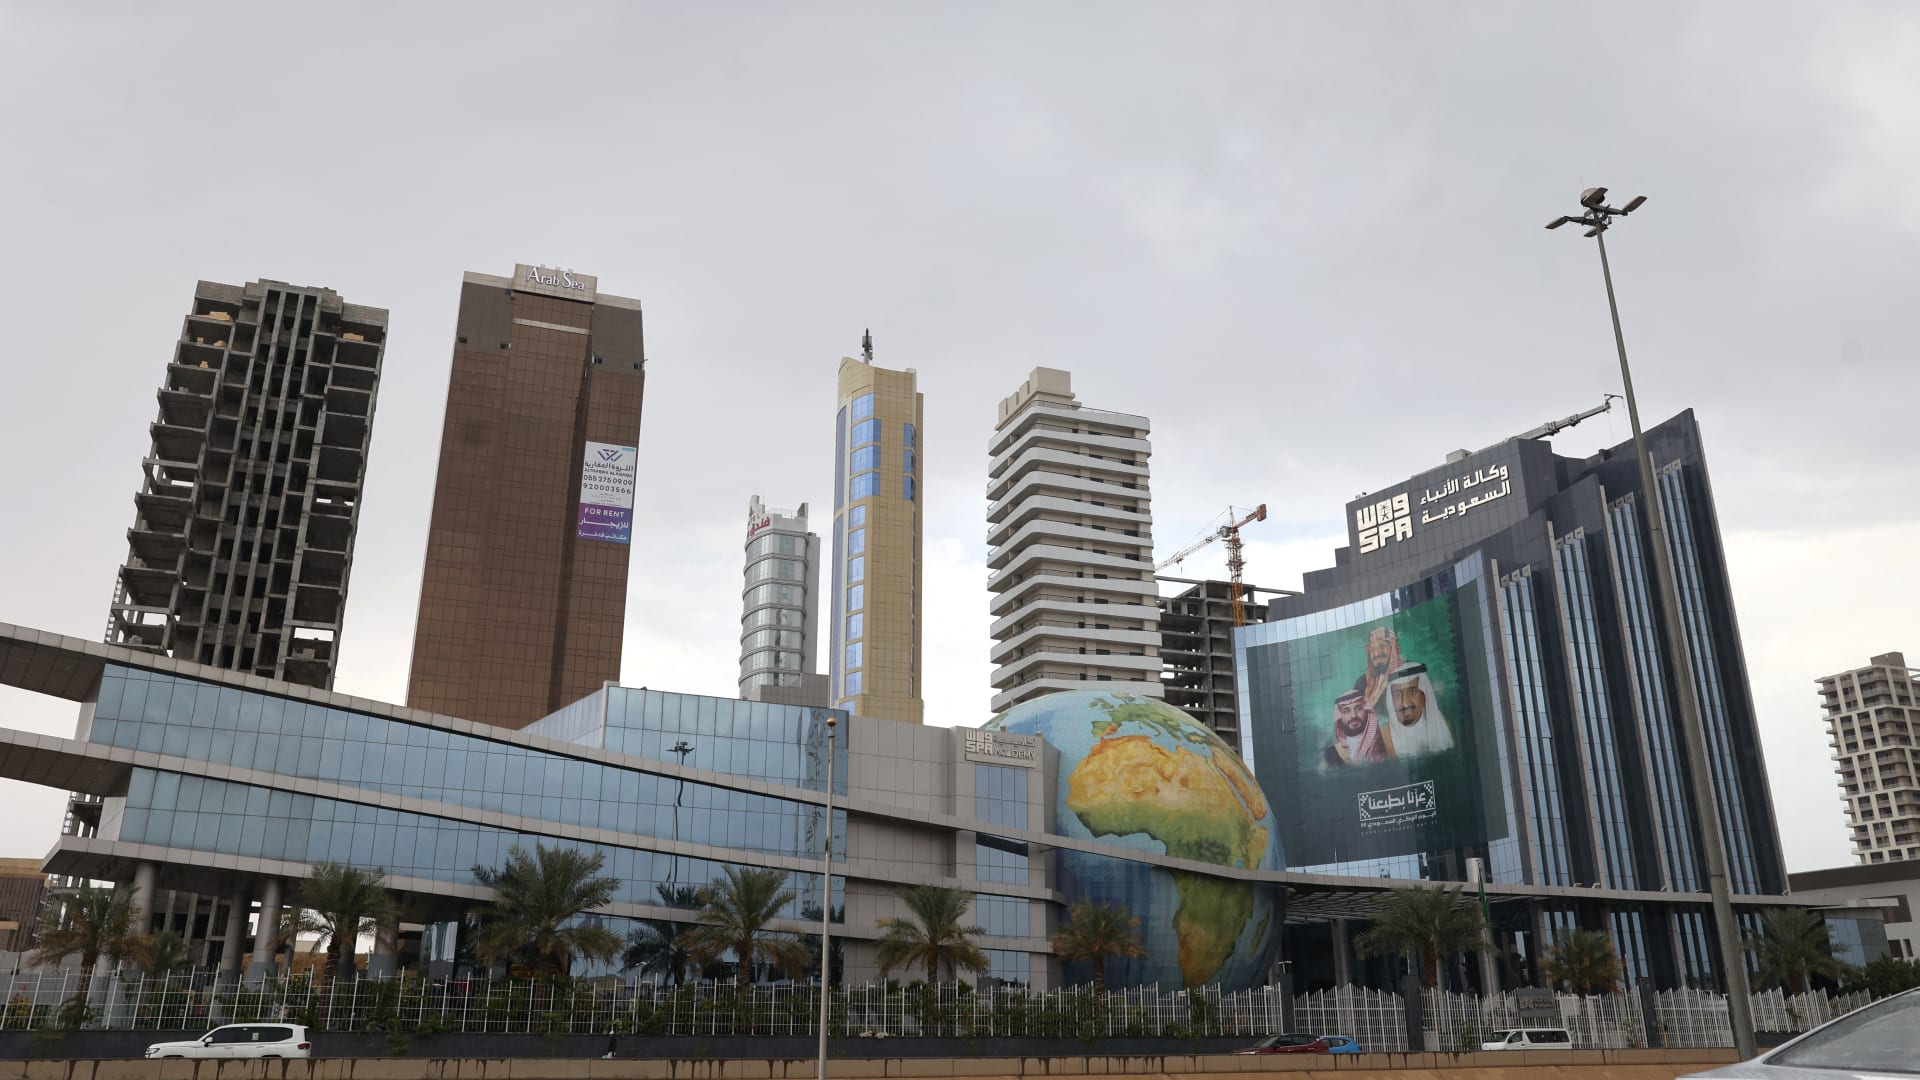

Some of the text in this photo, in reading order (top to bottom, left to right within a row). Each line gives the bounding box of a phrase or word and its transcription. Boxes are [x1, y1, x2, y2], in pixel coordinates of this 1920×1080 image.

[527, 266, 585, 290] Arab Sea
[1419, 464, 1509, 505] وكالة الأنباء
[584, 507, 624, 518] FOR RENT
[1421, 480, 1511, 525] السعودية
[1358, 515, 1413, 554] SPA
[966, 740, 993, 755] SPA
[995, 747, 1038, 760] ACADEMY
